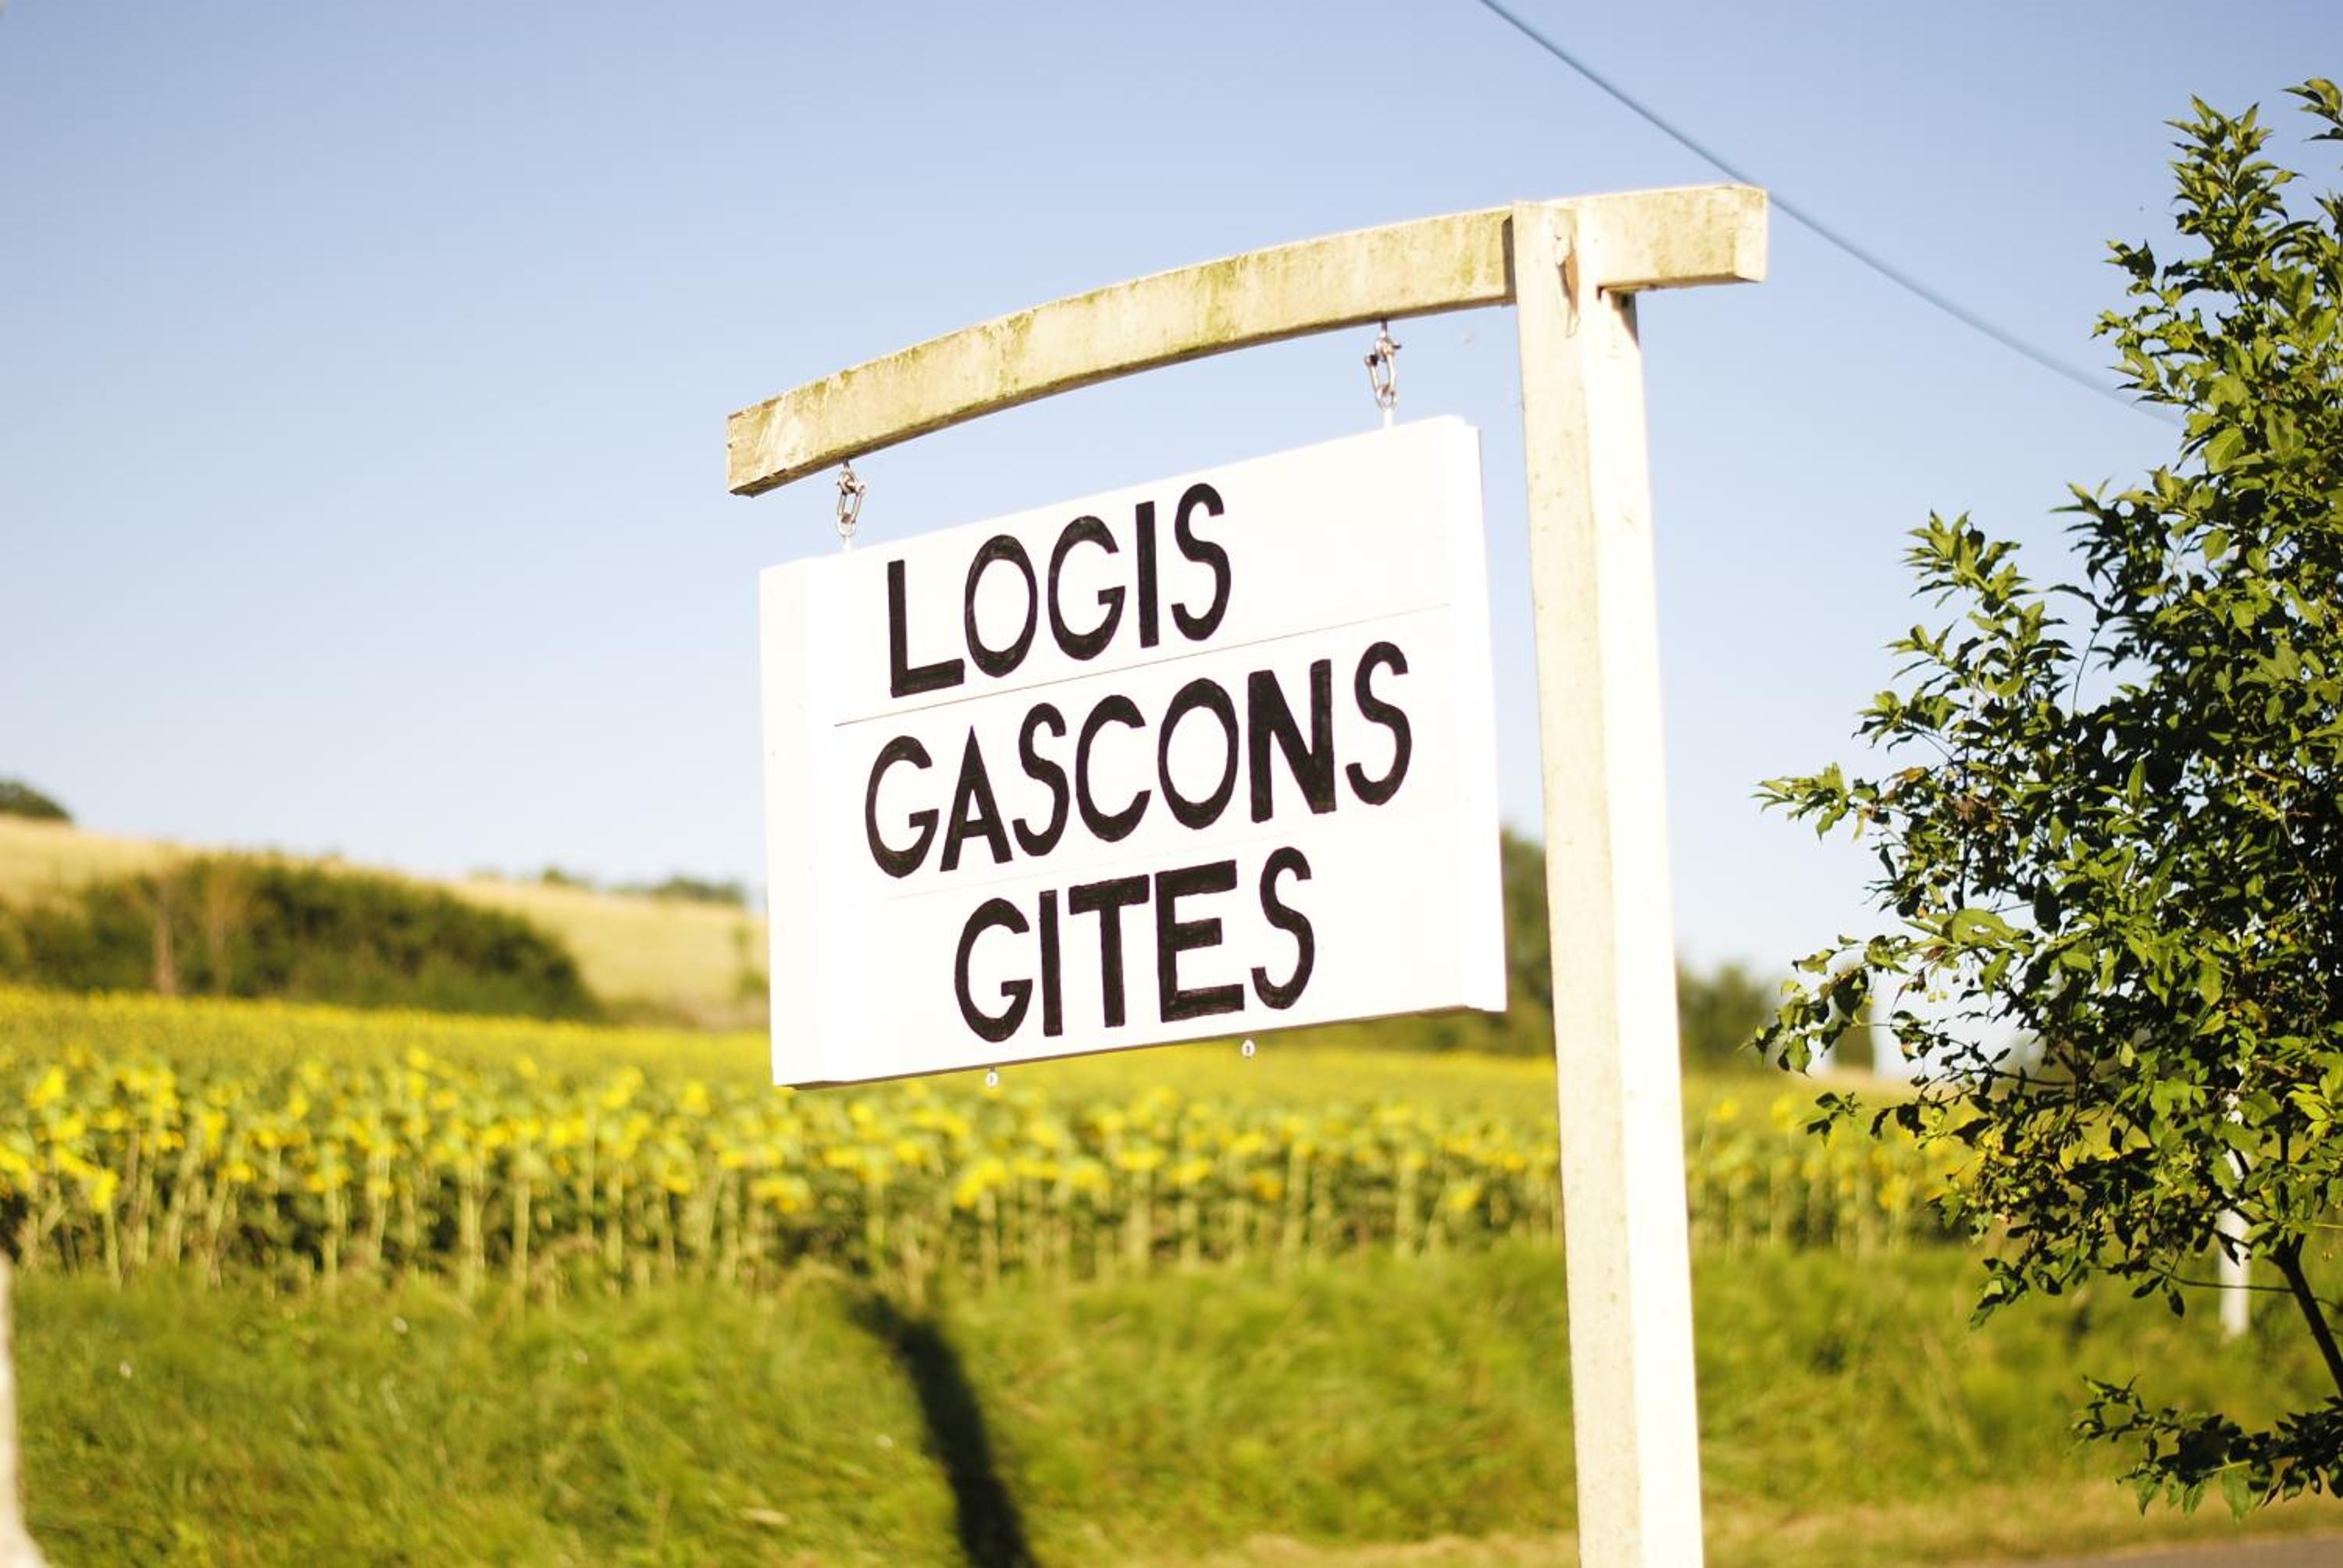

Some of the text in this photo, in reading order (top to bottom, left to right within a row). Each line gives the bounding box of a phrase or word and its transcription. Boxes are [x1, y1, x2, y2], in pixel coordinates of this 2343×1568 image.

[887, 483, 1232, 699] LOGIS
[865, 641, 1412, 878] GASCONS
[954, 846, 1315, 1043] GITES
